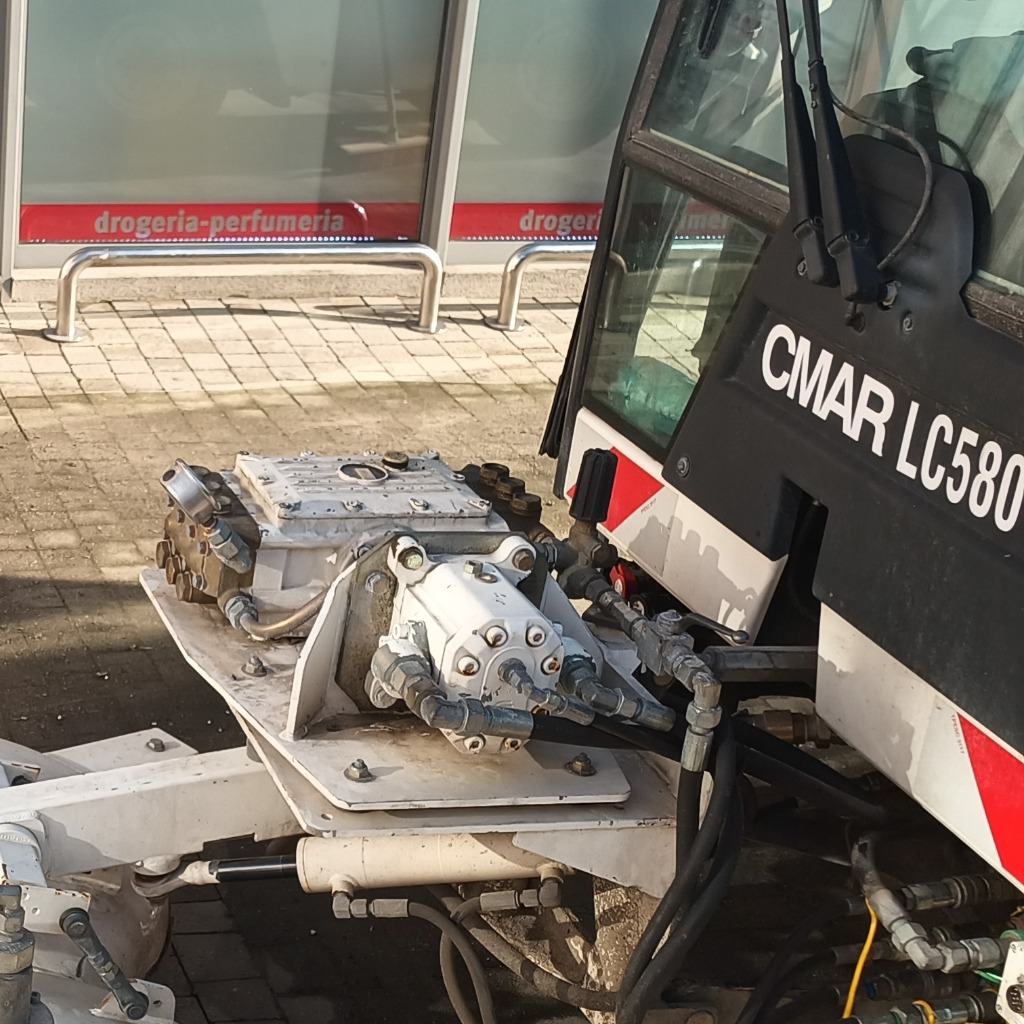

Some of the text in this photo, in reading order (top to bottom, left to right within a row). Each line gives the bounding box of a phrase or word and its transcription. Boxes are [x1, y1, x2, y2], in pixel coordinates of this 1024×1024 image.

[93, 209, 345, 239] drogeria-perfumeria
[762, 323, 1024, 532] CMAR LC580
